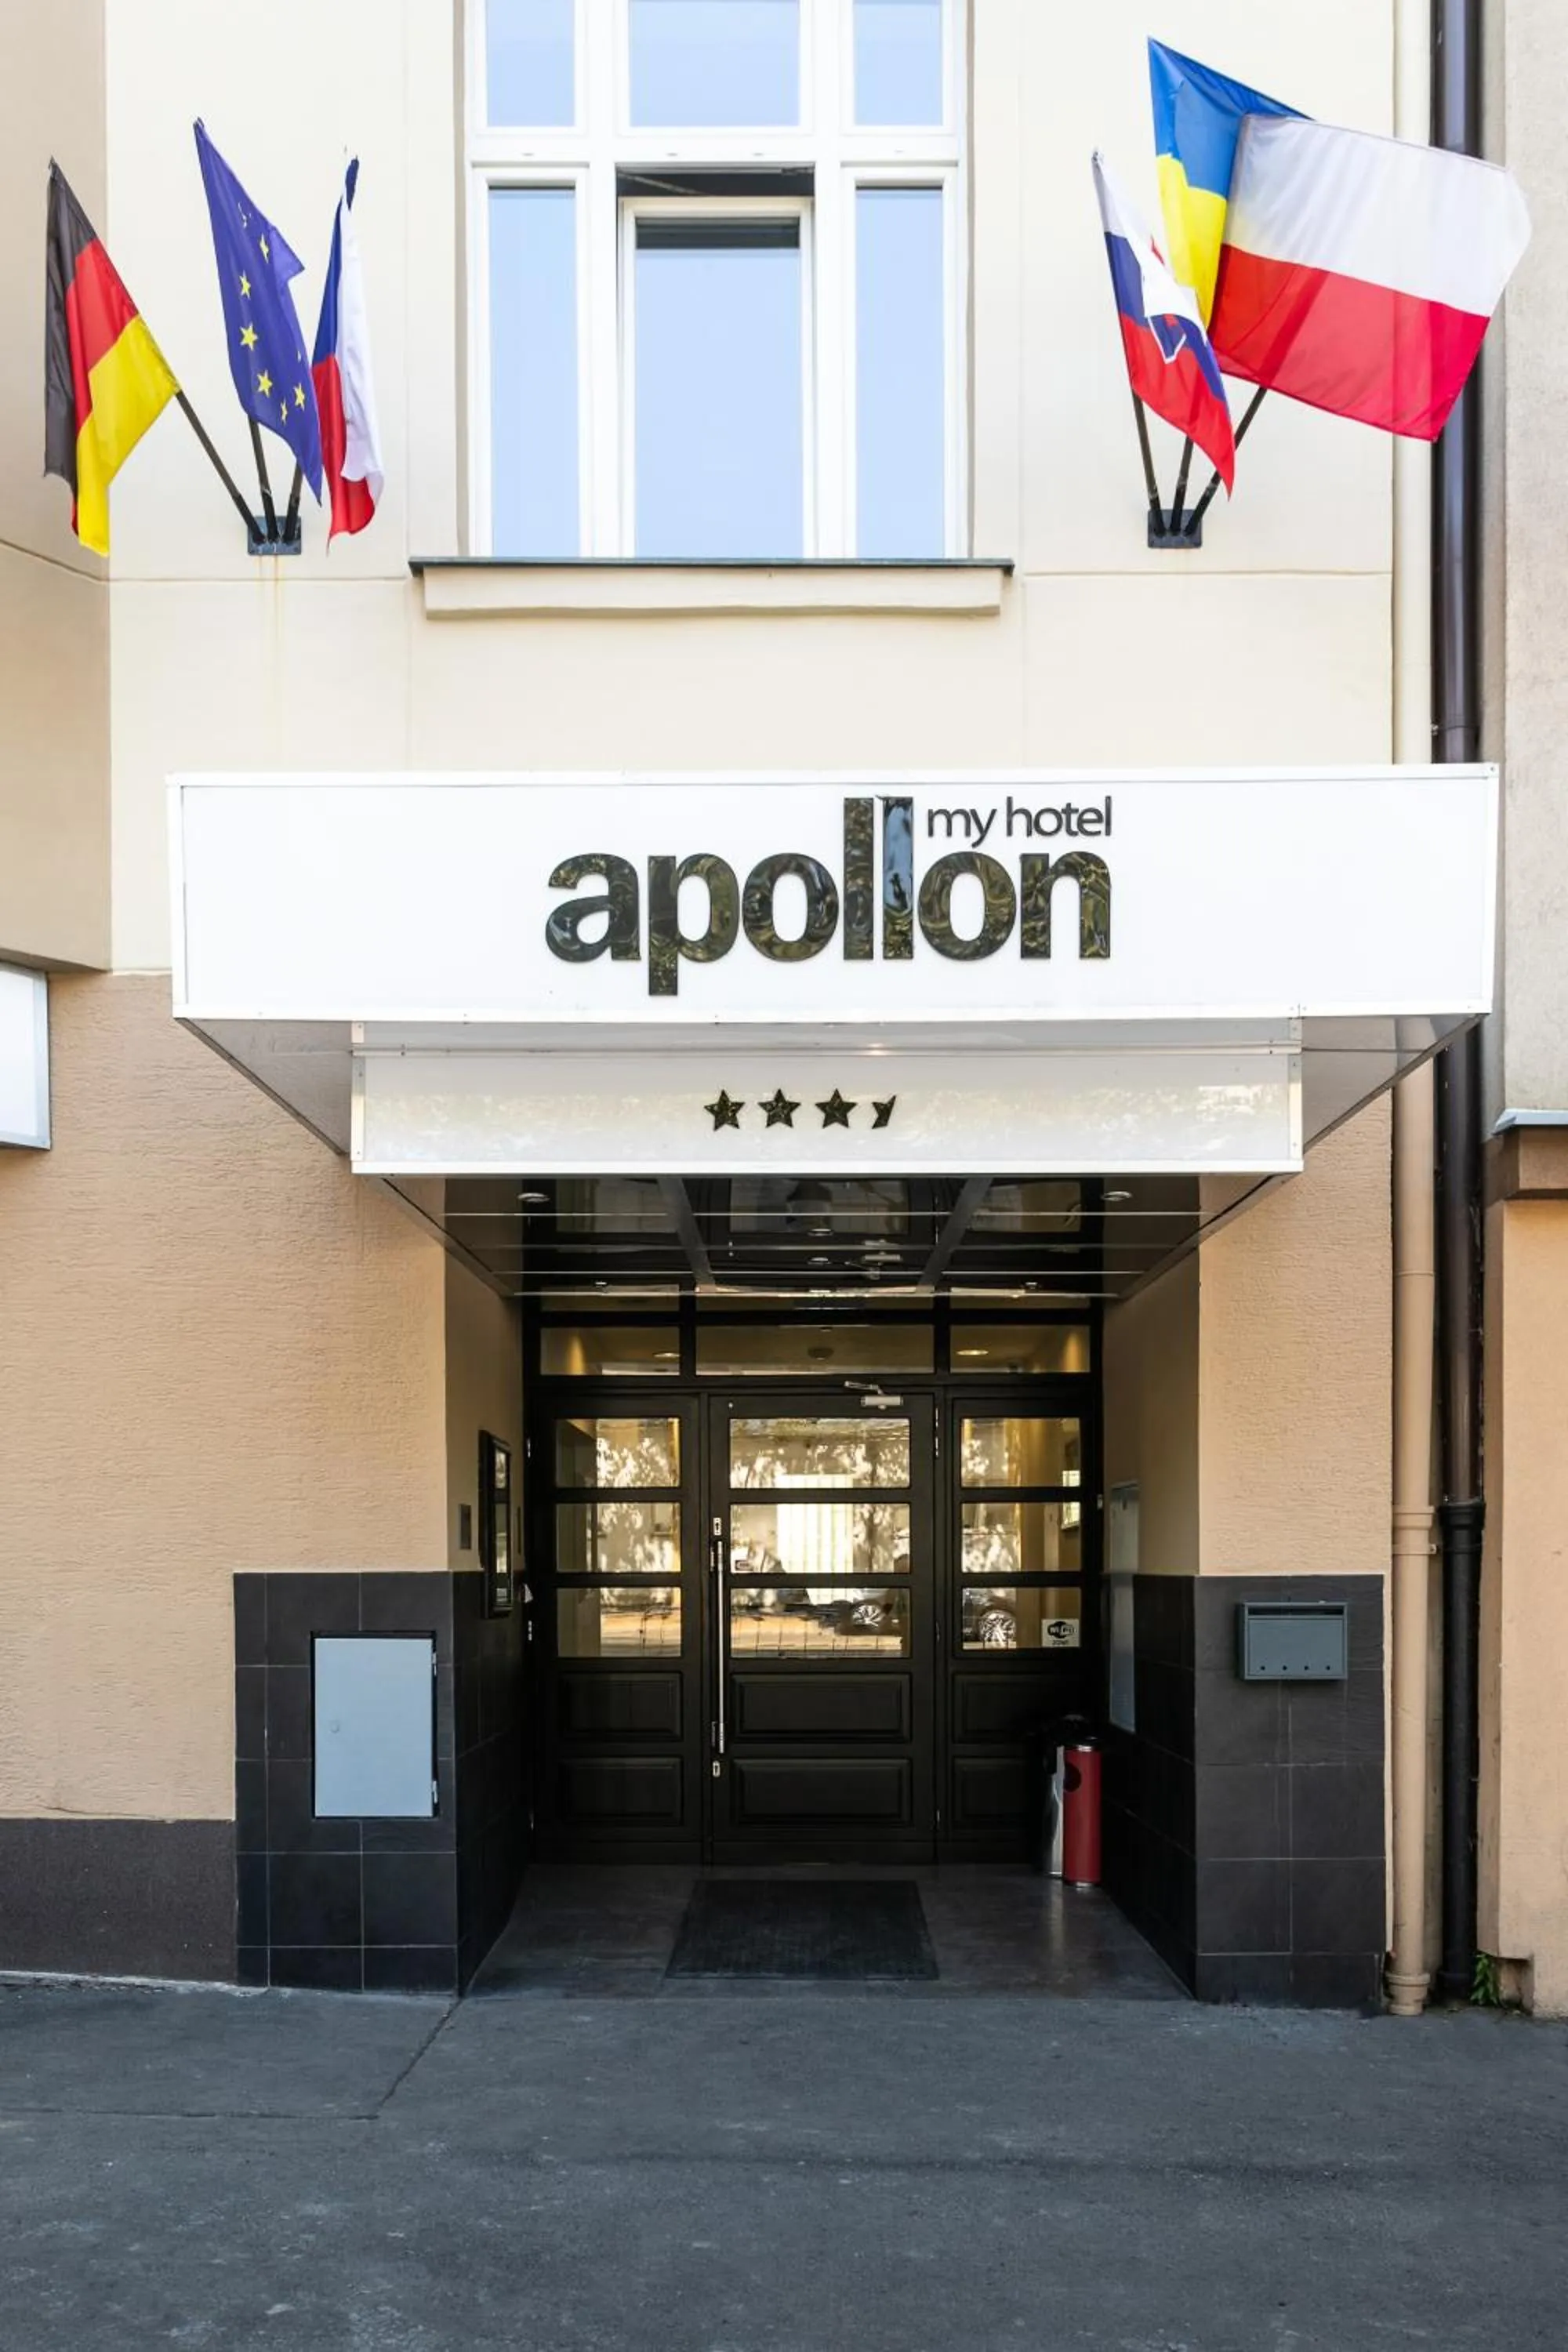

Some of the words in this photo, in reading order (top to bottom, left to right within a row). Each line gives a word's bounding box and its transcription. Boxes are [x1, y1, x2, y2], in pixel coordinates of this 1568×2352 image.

[927, 808, 997, 848] my
[1006, 796, 1112, 837] hotel
[546, 796, 1112, 996] apollon
